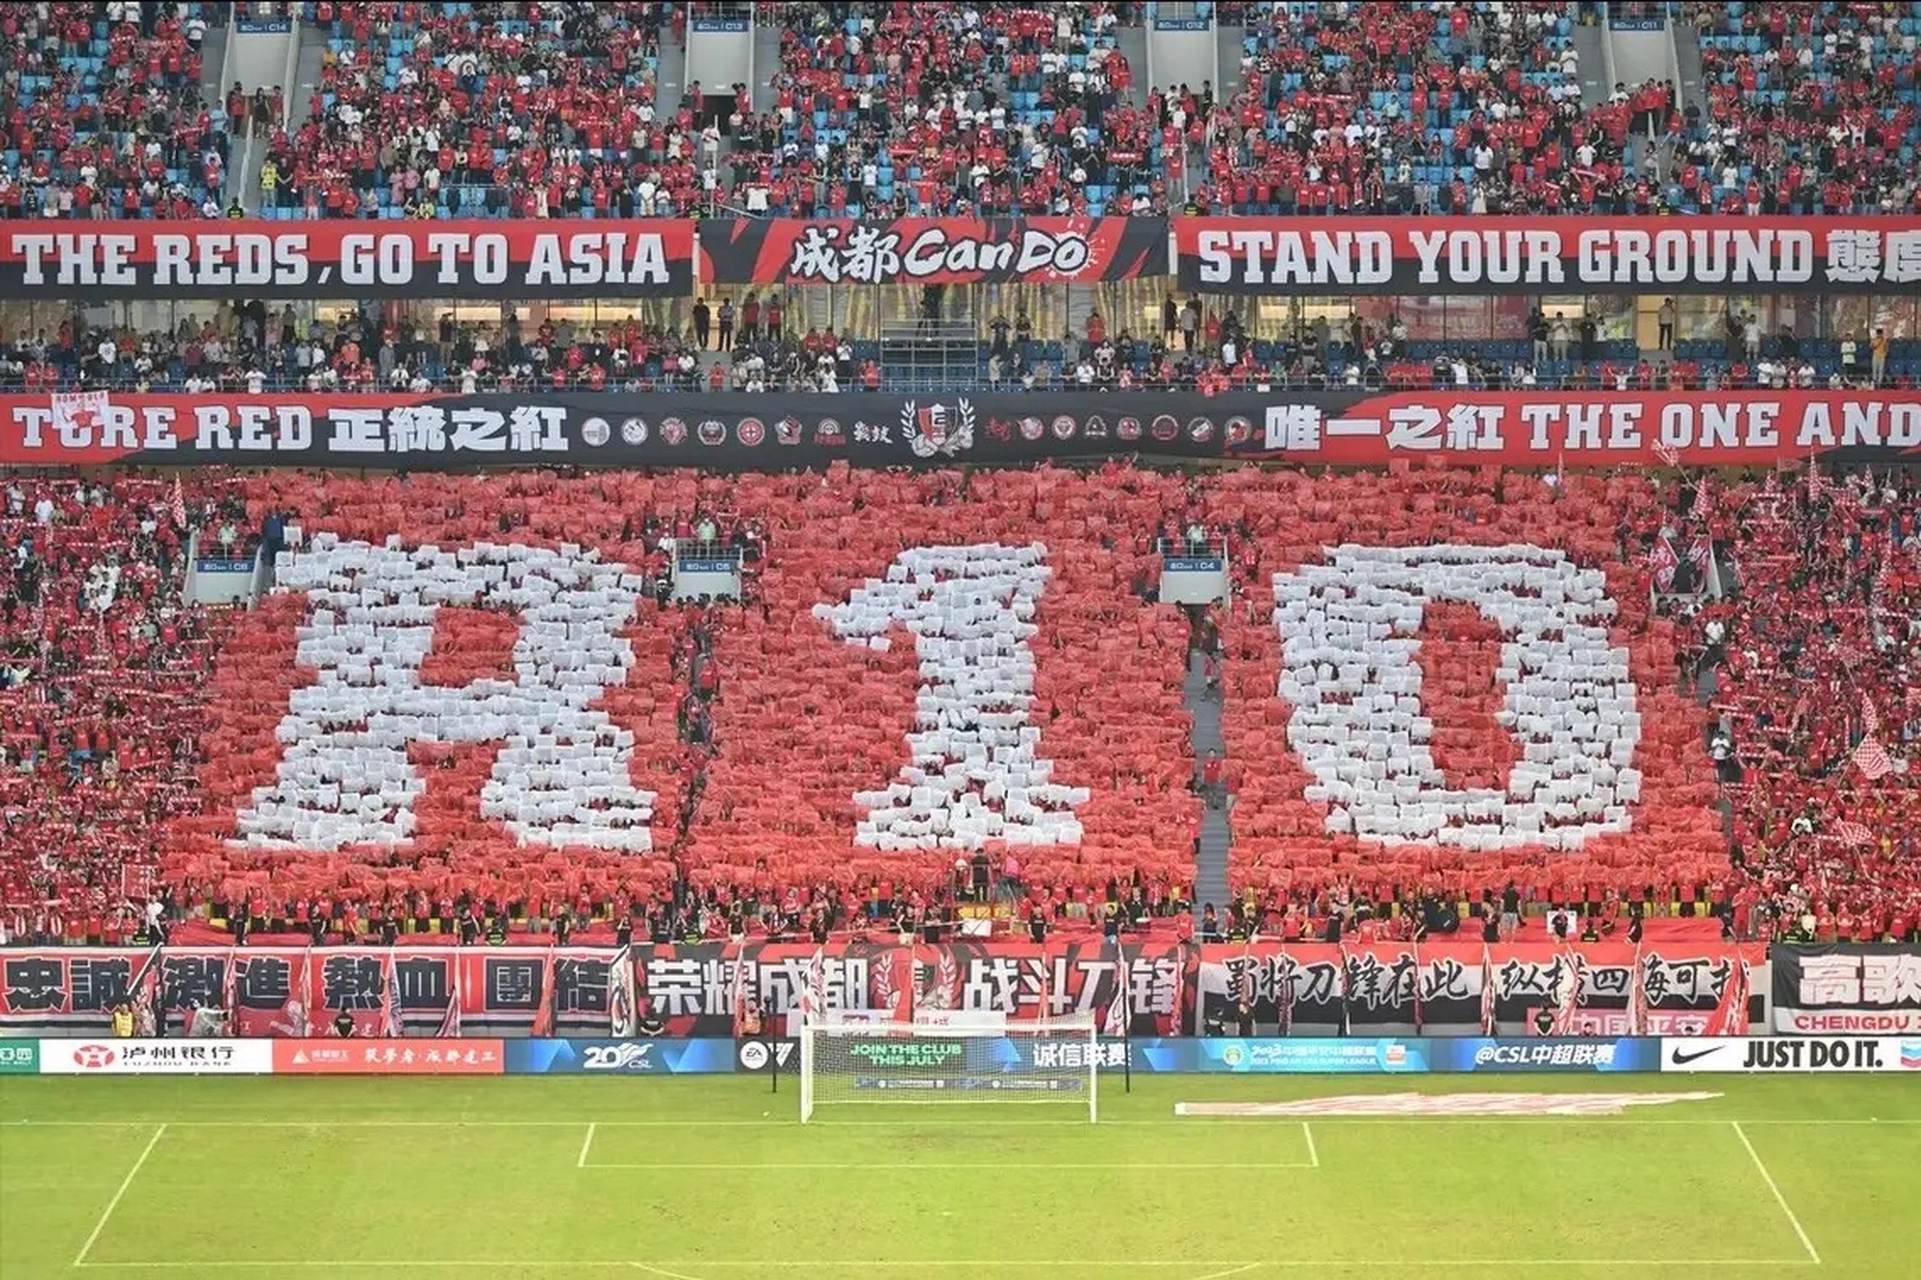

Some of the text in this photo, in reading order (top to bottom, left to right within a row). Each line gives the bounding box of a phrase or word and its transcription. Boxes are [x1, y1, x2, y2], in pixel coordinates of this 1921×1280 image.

[268, 23, 286, 31] C14
[12, 234, 136, 284] THE
[341, 234, 413, 284] GO
[428, 233, 508, 284] TO
[525, 233, 670, 284] ASIA
[1198, 229, 1921, 284] STAND YOUR GROUND 態度
[194, 405, 312, 450] RED
[328, 405, 569, 452] 正統之紅
[1265, 402, 1921, 450] 唯一之紅 THE ONE AND
[1199, 562, 1215, 570] C4
[4, 957, 131, 1012] 忠誠
[322, 954, 450, 1010] 熱血
[648, 957, 1184, 1015] 荣耀成都 战斗刀锋
[1795, 1015, 1910, 1030] CHENGDU
[122, 1046, 235, 1060] 泸州银行
[746, 1048, 763, 1058] EA
[851, 1044, 962, 1055] JOIN THE CLUB
[1033, 1043, 1131, 1067] 诚信联赛
[1475, 1044, 1617, 1065] @CSL中超联赛
[1743, 1040, 1883, 1067] JUST DO IT.
[628, 1059, 653, 1069] CSL
[869, 1055, 944, 1066] THIS JULY
